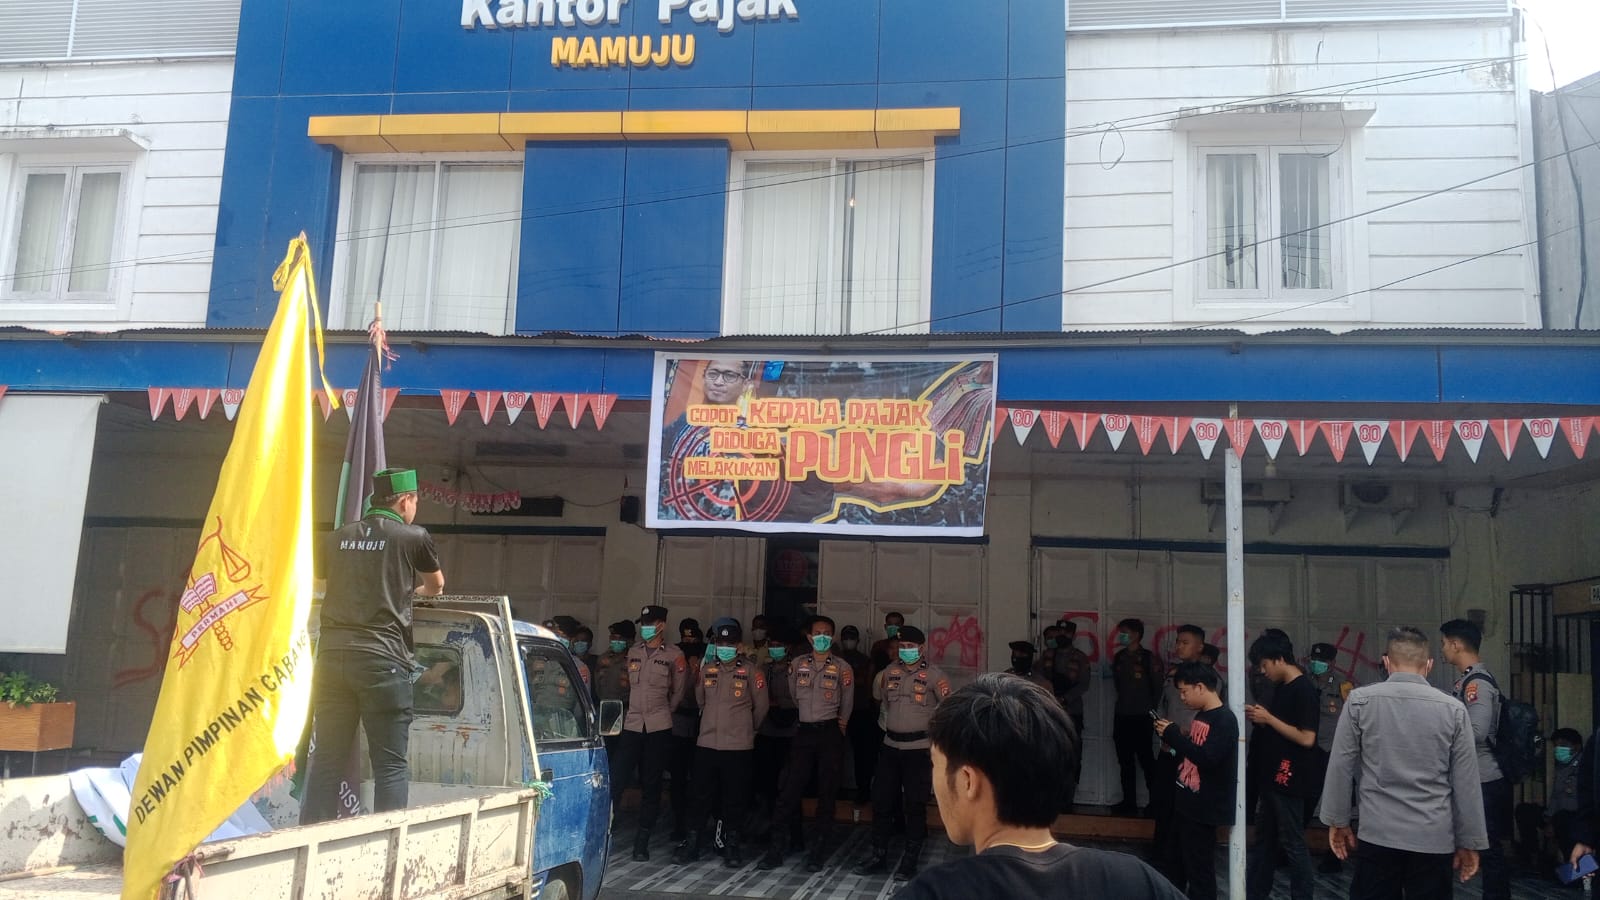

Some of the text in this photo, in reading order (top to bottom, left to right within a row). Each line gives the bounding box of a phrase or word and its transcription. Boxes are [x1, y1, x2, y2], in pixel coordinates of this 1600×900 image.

[461, 0, 628, 29] Kantor
[551, 34, 695, 67] MAMUJU
[507, 392, 526, 408] 80
[690, 401, 929, 427] COPOT KEPALA PAJAK
[1012, 409, 1034, 428] 80
[1106, 414, 1128, 432] 80
[1195, 423, 1219, 440] 80
[1261, 422, 1284, 440] 80
[1359, 424, 1382, 442] 80
[1459, 421, 1484, 440] 80
[1529, 418, 1553, 437] 80
[687, 460, 777, 477] MELAKUKAN
[191, 597, 239, 639] PERMAHI
[134, 760, 186, 824] DEWAN
[184, 686, 265, 767] PIMPINAN
